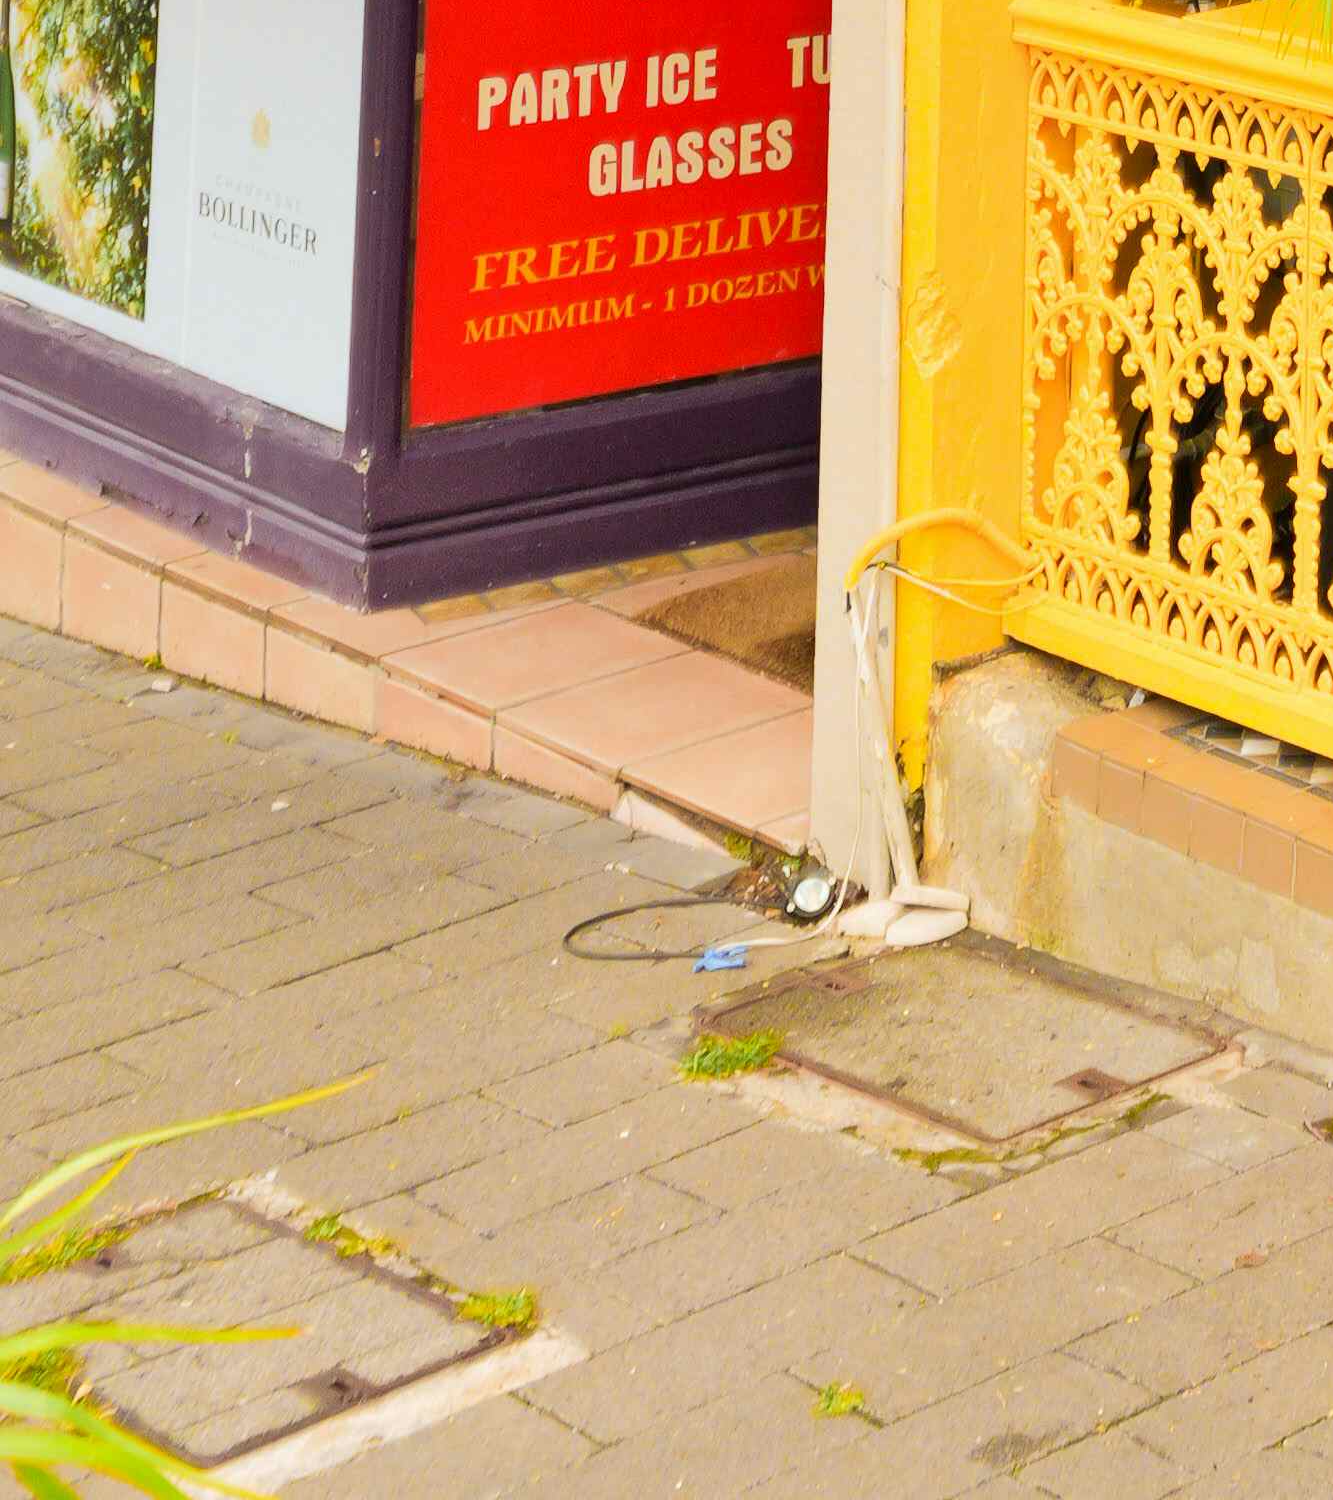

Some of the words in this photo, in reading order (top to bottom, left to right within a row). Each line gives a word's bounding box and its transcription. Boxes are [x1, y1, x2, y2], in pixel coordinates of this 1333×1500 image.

[477, 60, 627, 131] PARTY
[646, 48, 717, 108] ICE
[588, 118, 793, 197] GLASSES
[199, 191, 317, 257] BOLLINGER
[469, 234, 617, 293] FREE
[629, 202, 827, 268] DELIVE
[462, 292, 635, 345] MINIMUM
[664, 286, 676, 312] 1
[686, 269, 800, 308] DOZEN
